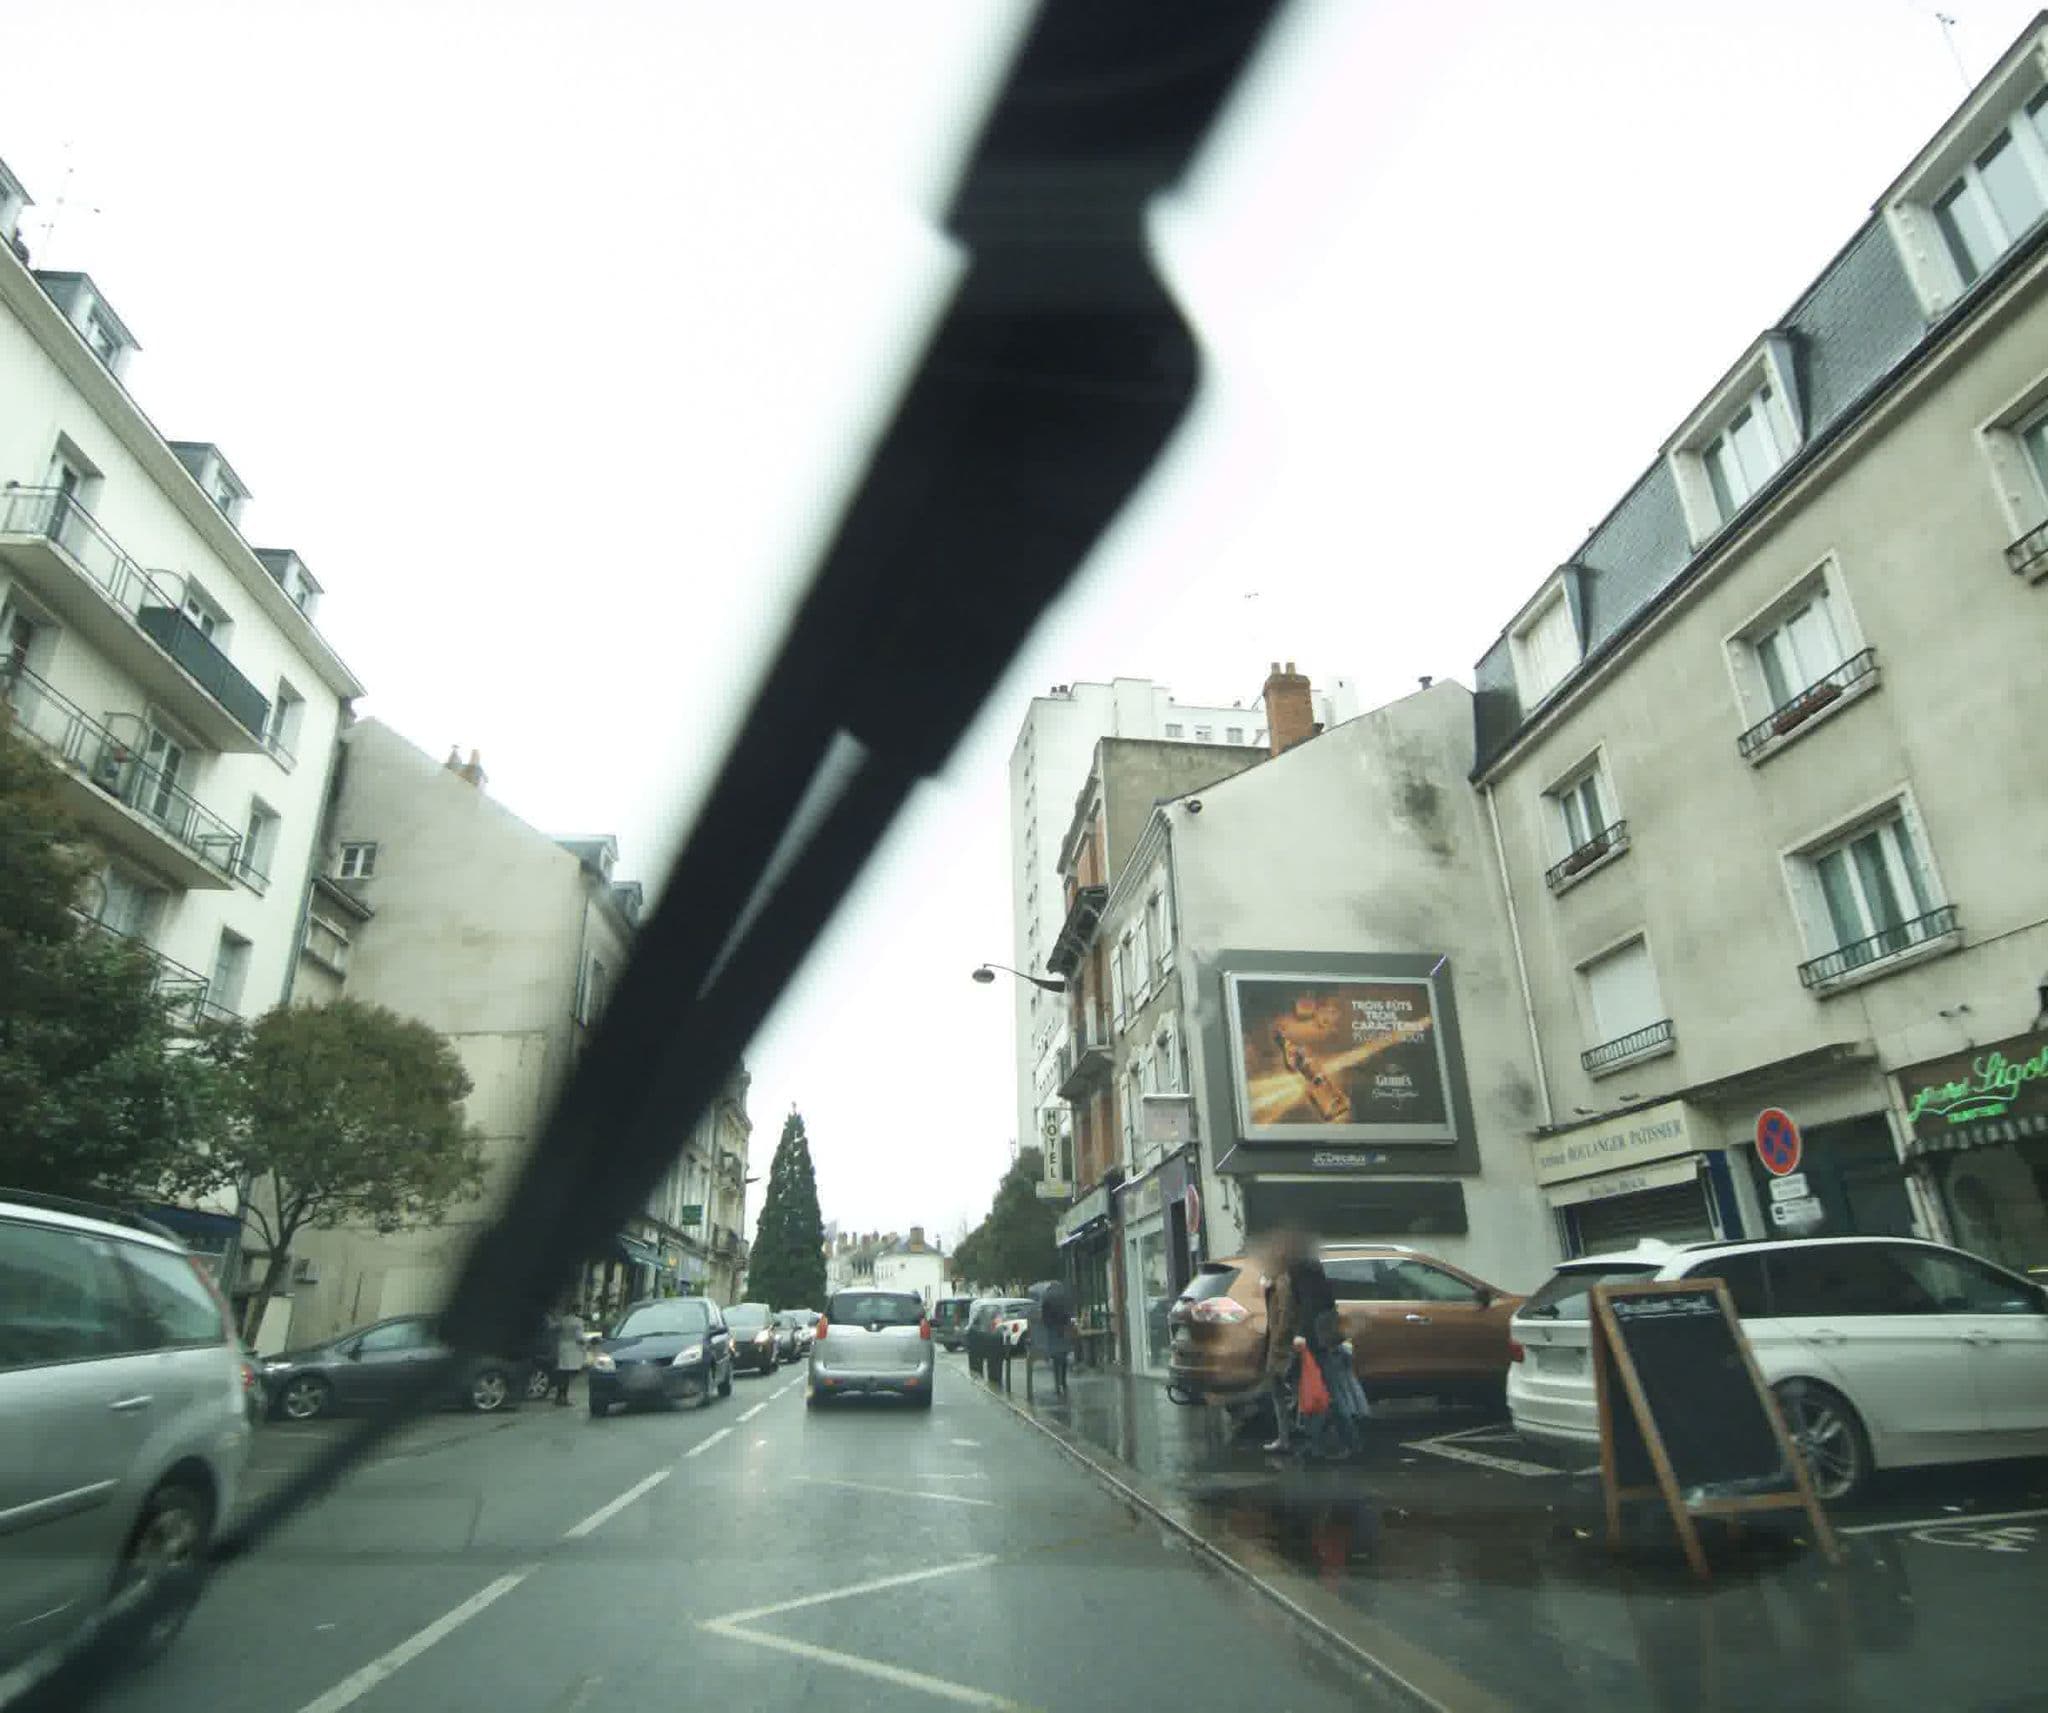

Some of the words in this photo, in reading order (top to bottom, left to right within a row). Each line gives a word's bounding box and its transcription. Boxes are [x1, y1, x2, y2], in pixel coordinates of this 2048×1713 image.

[1366, 1011, 1398, 1020] TROIS
[1046, 1110, 1057, 1179] HOTEL
[1567, 1134, 1626, 1160] BOULANGER
